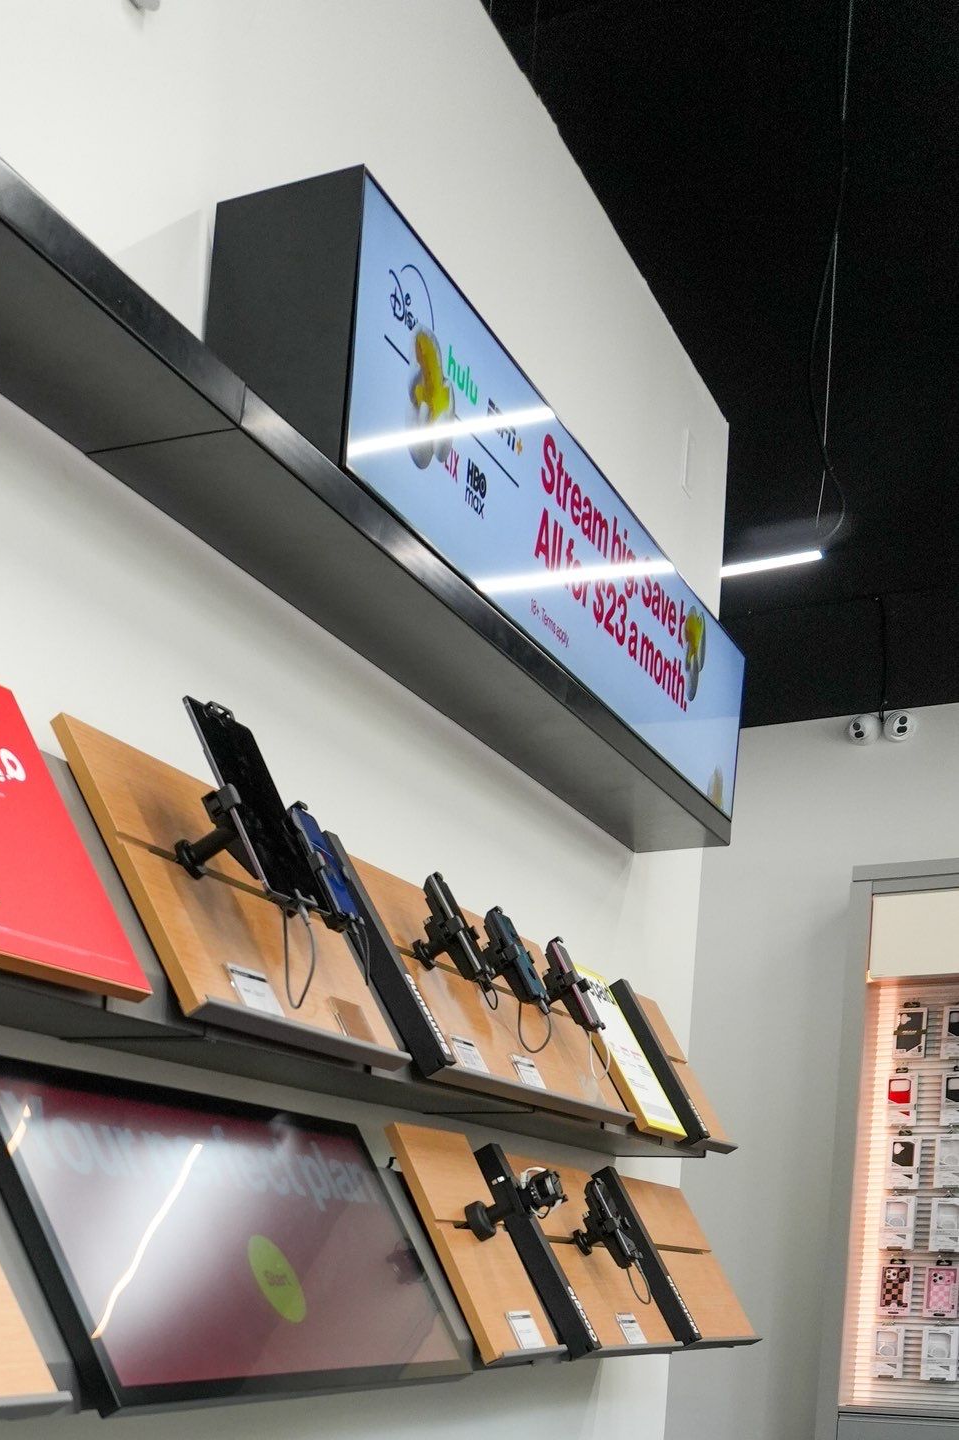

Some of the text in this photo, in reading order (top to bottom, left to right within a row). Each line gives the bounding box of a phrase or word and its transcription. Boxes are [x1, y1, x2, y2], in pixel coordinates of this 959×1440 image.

[447, 344, 478, 405] hulu
[465, 485, 485, 519] max
[467, 457, 487, 500] HBO
[541, 434, 608, 559] Stream
[641, 556, 677, 637] Save
[534, 507, 563, 572] All
[592, 576, 627, 646] $23
[628, 621, 638, 661] a
[639, 631, 687, 712] month.
[405, 973, 451, 1055] Samsung
[567, 1285, 598, 1343] Google
